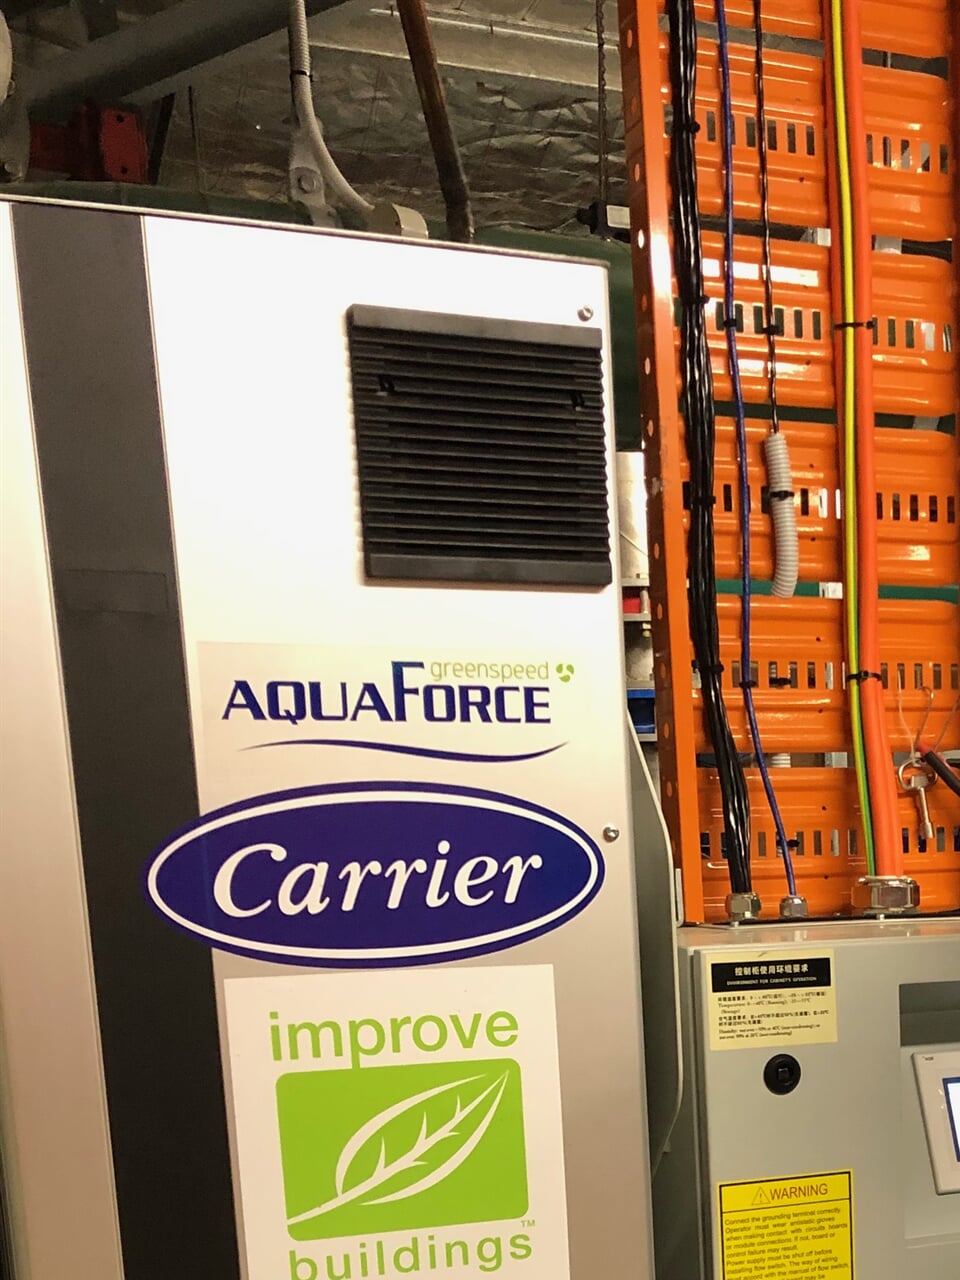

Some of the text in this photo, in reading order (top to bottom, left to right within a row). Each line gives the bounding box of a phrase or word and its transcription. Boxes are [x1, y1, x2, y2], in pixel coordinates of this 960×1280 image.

[430, 661, 549, 682] greenspeed
[213, 840, 543, 918] Carrier
[269, 1010, 519, 1070] improve
[770, 1184, 828, 1201] WARNING
